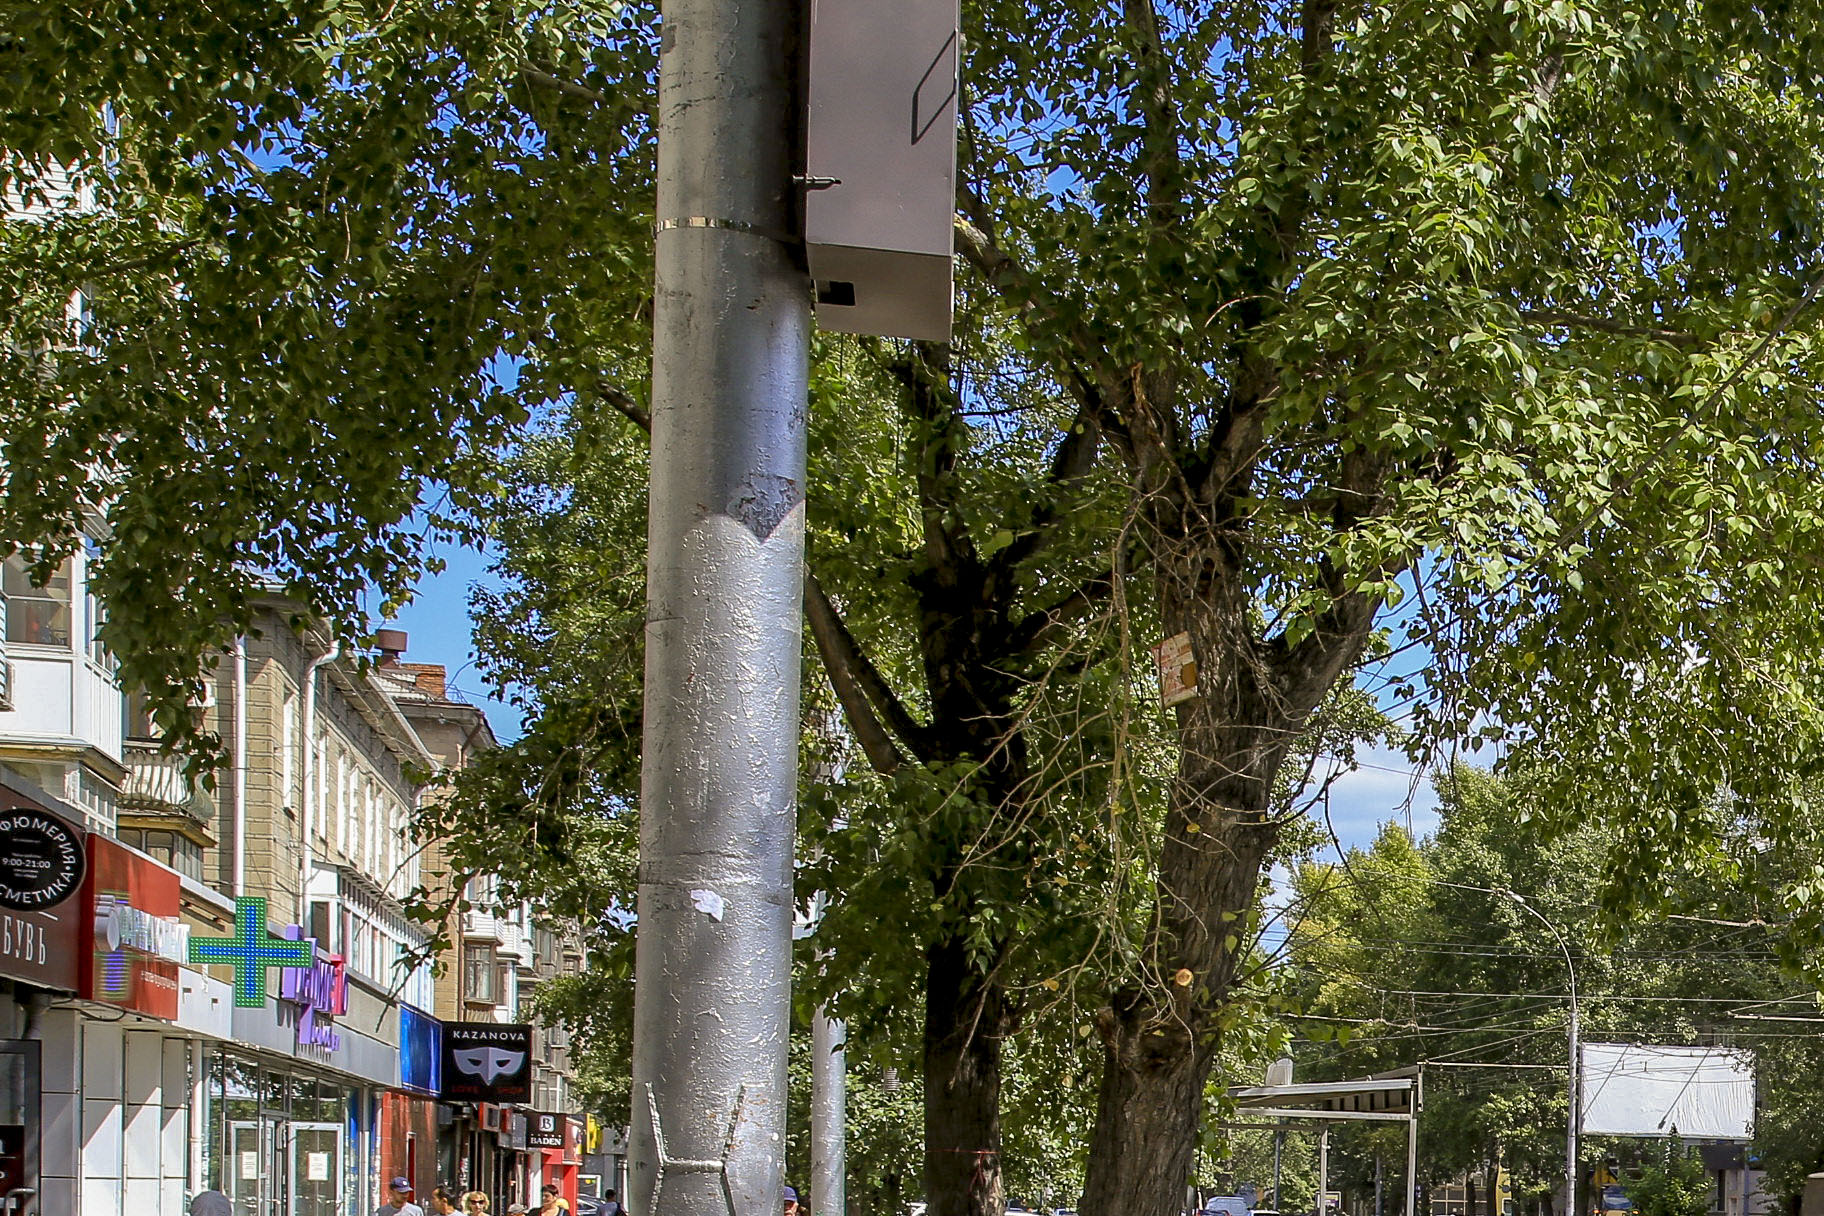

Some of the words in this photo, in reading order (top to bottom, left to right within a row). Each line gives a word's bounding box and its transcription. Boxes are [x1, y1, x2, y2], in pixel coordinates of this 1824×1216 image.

[2, 857, 51, 869] 9:00-21:00
[453, 1030, 526, 1042] KAZANOVA
[530, 1137, 562, 1146] BADEN
